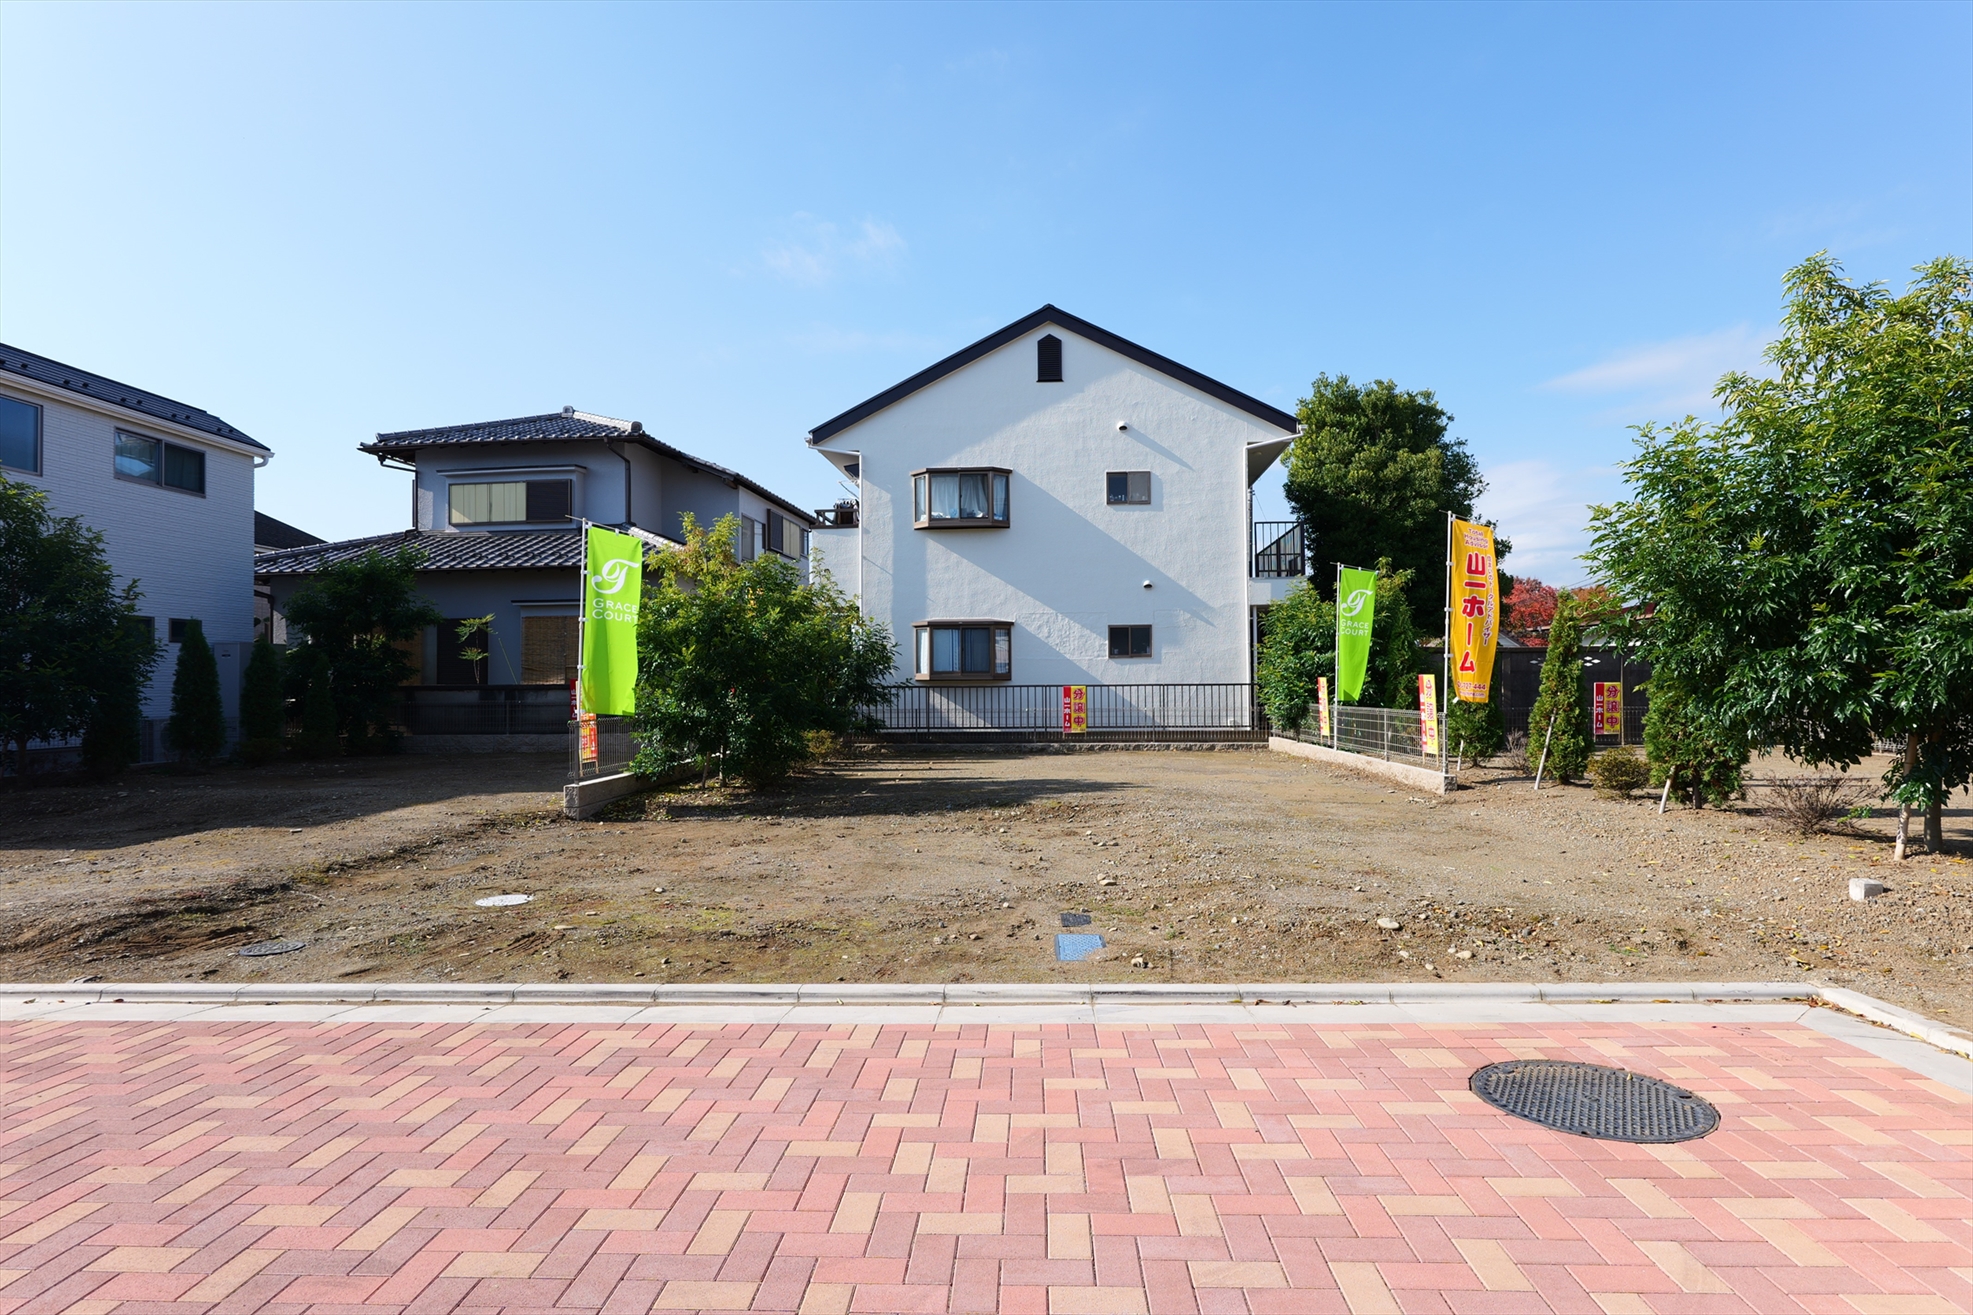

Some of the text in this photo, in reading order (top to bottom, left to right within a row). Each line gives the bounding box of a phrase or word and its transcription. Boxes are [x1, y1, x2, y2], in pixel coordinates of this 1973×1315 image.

[1468, 527, 1484, 537] Total
[592, 597, 639, 614] GRACE
[1460, 552, 1487, 673] 山一ホーム
[592, 608, 639, 625] COURT
[1340, 618, 1370, 629] GRACE
[1340, 626, 1369, 637] COURT
[1074, 688, 1086, 727] 分譲中
[1596, 694, 1604, 728] 山一ホーム
[1606, 685, 1620, 728] 分譲中
